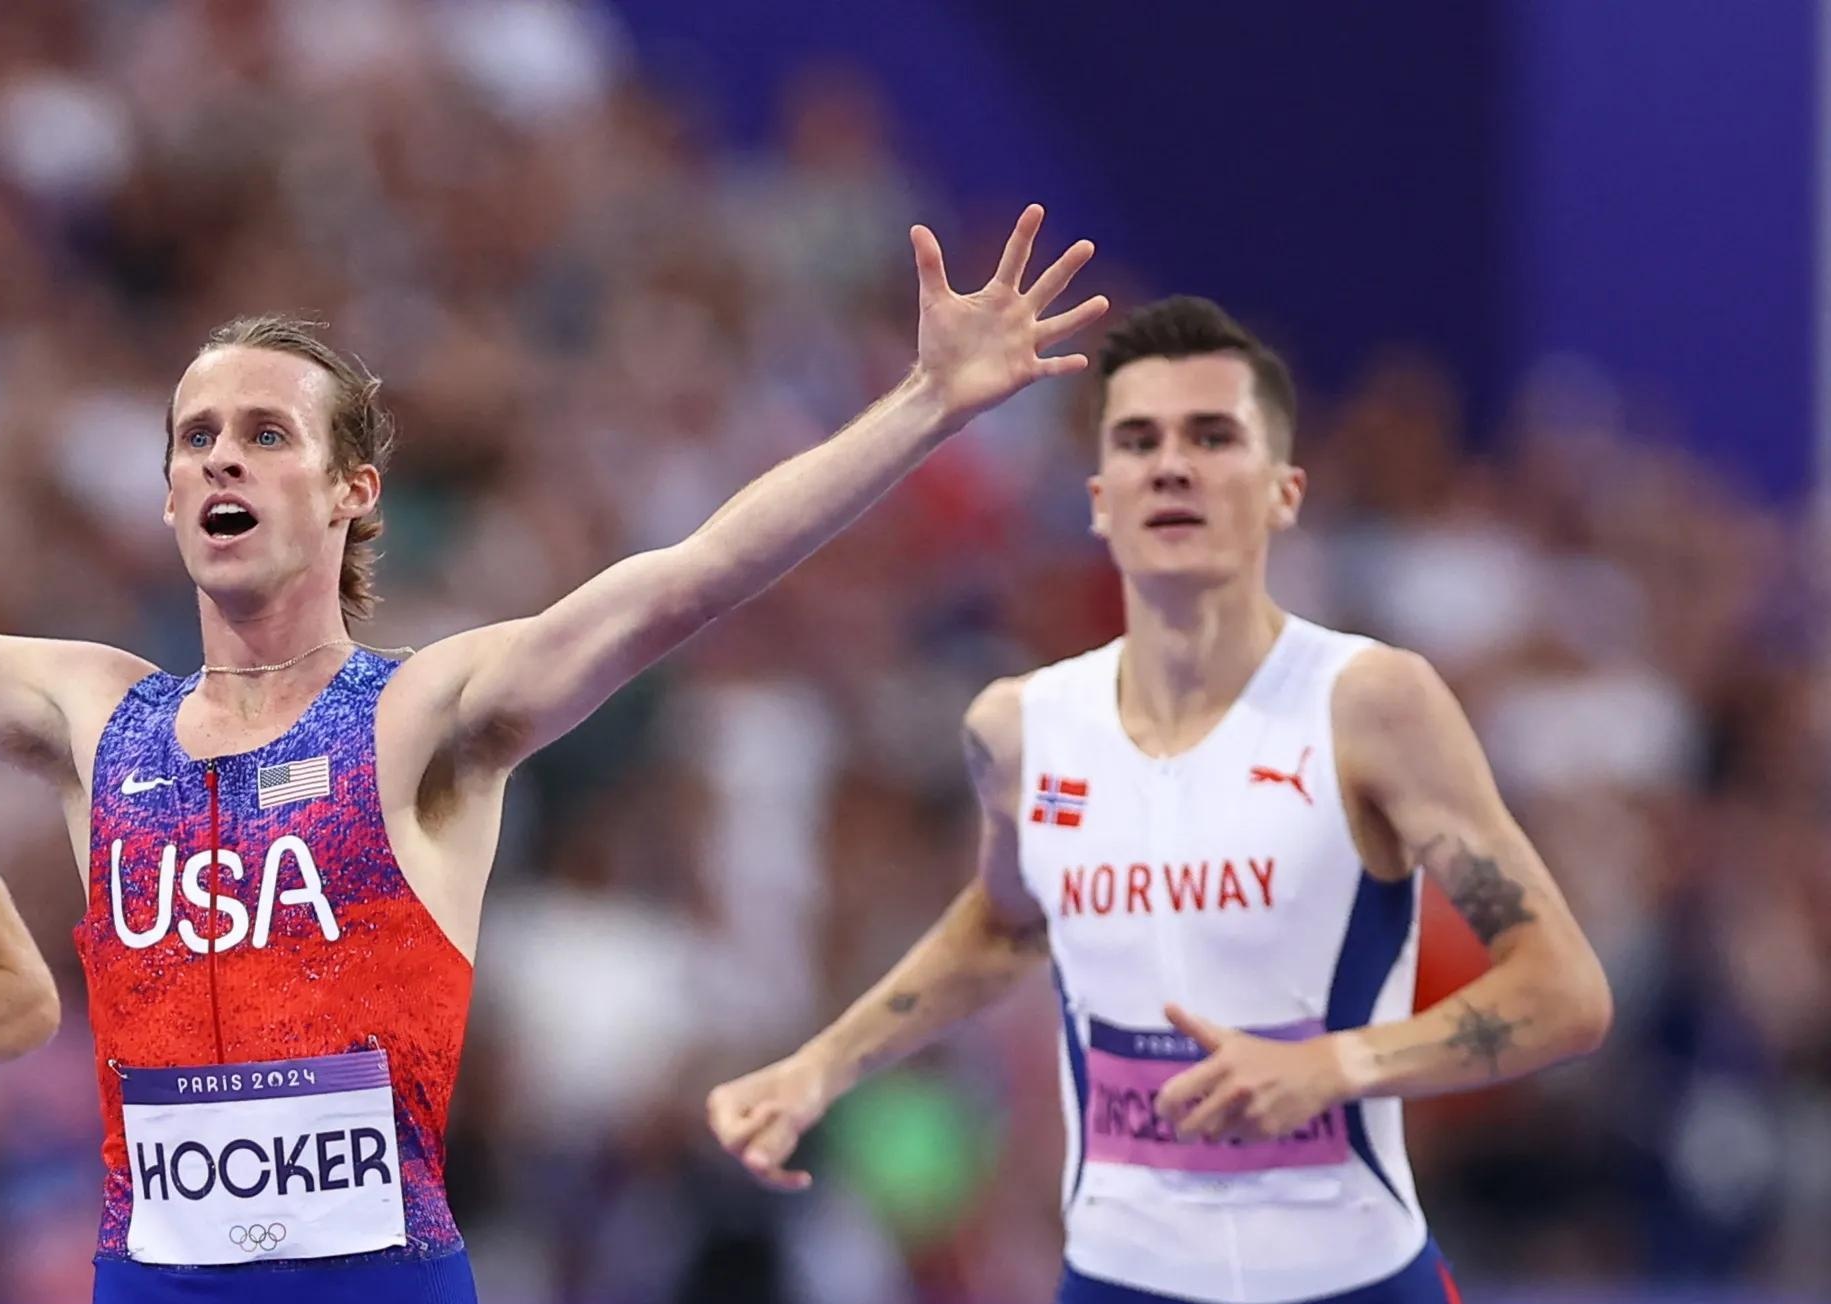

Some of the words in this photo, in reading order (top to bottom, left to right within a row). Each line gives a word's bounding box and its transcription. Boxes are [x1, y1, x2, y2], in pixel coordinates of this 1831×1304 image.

[110, 834, 339, 954] USA
[1060, 856, 1274, 917] NORWAY
[177, 1074, 242, 1094] PARIS
[252, 1068, 316, 1090] 2024
[136, 1127, 392, 1201] HOCKER
